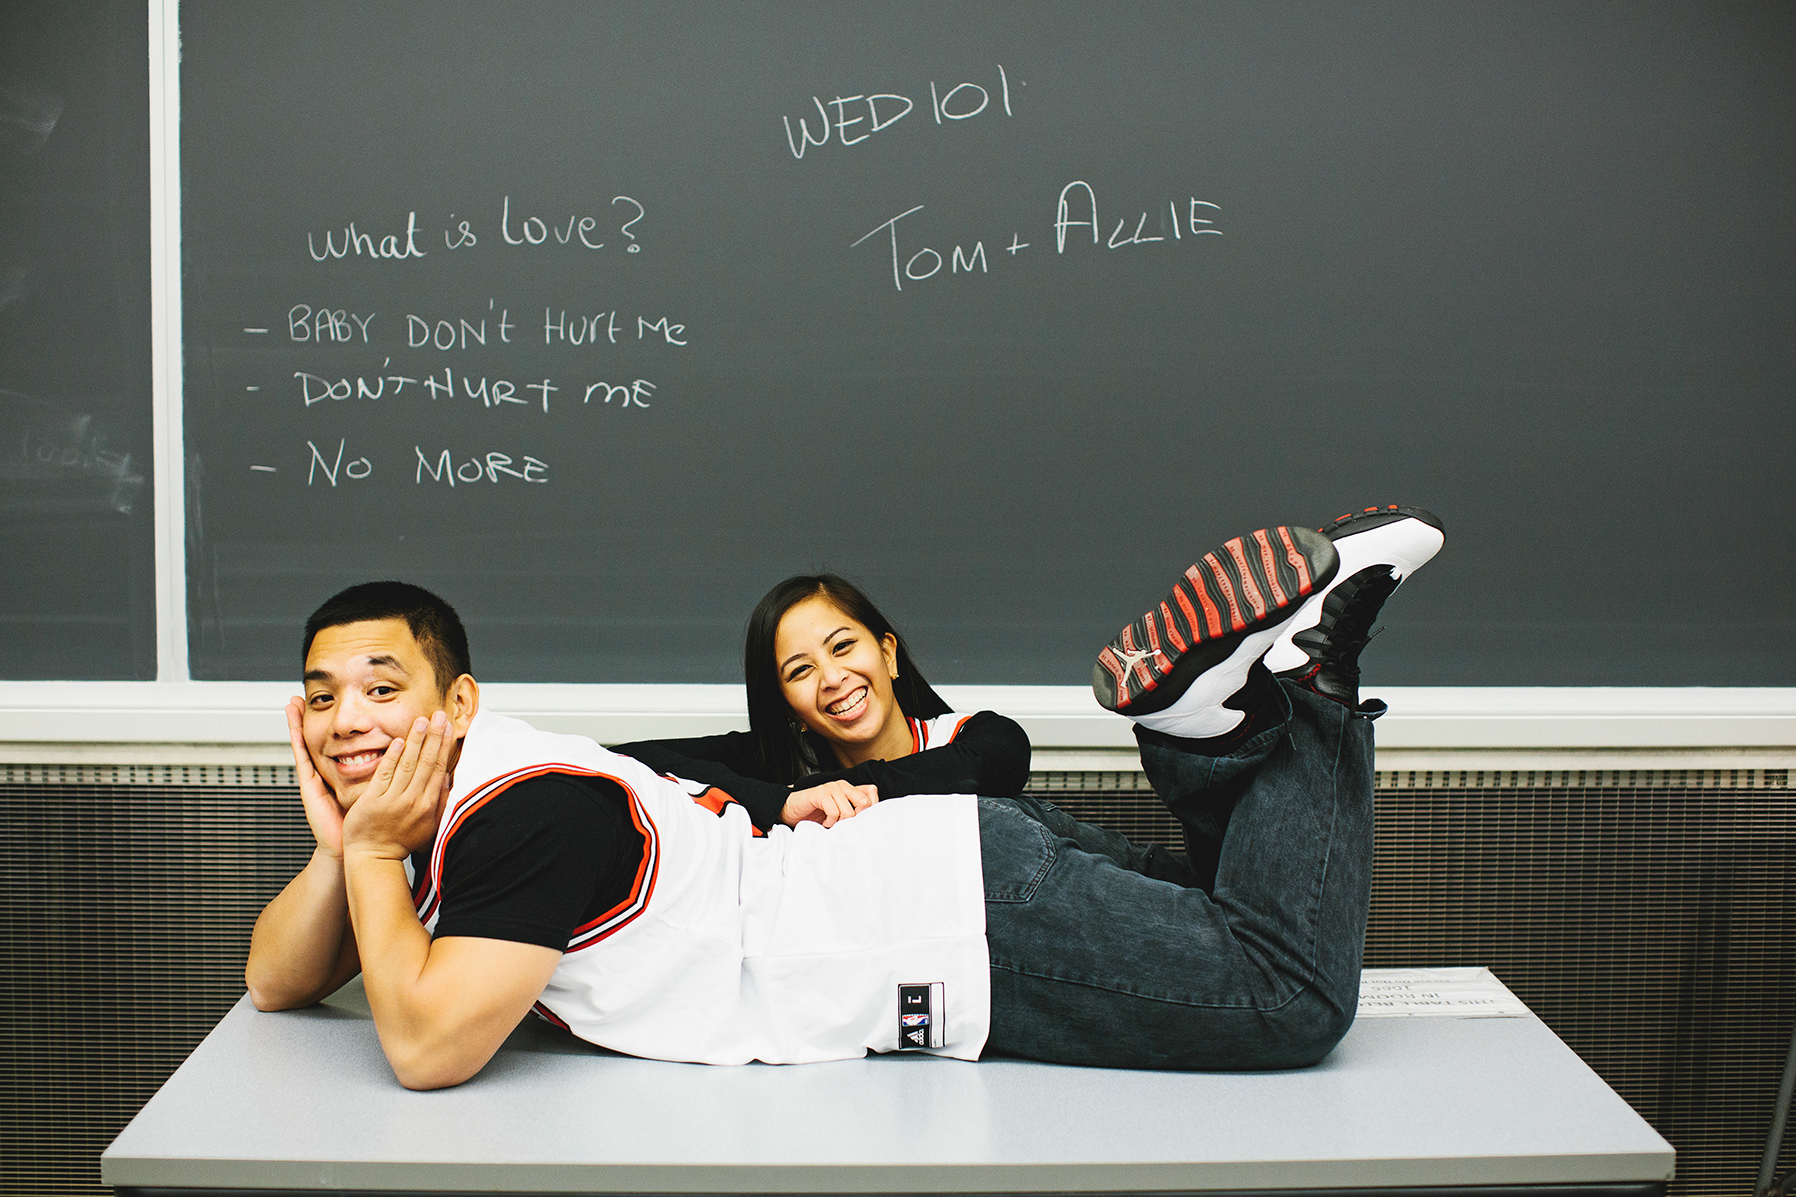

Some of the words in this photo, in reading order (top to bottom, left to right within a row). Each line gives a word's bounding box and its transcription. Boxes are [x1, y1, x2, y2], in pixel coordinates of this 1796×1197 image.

[783, 94, 913, 159] WED
[445, 214, 477, 249] is
[1054, 181, 1223, 254] ALLIE
[288, 304, 375, 342] BABY
[415, 446, 548, 487] MORE
